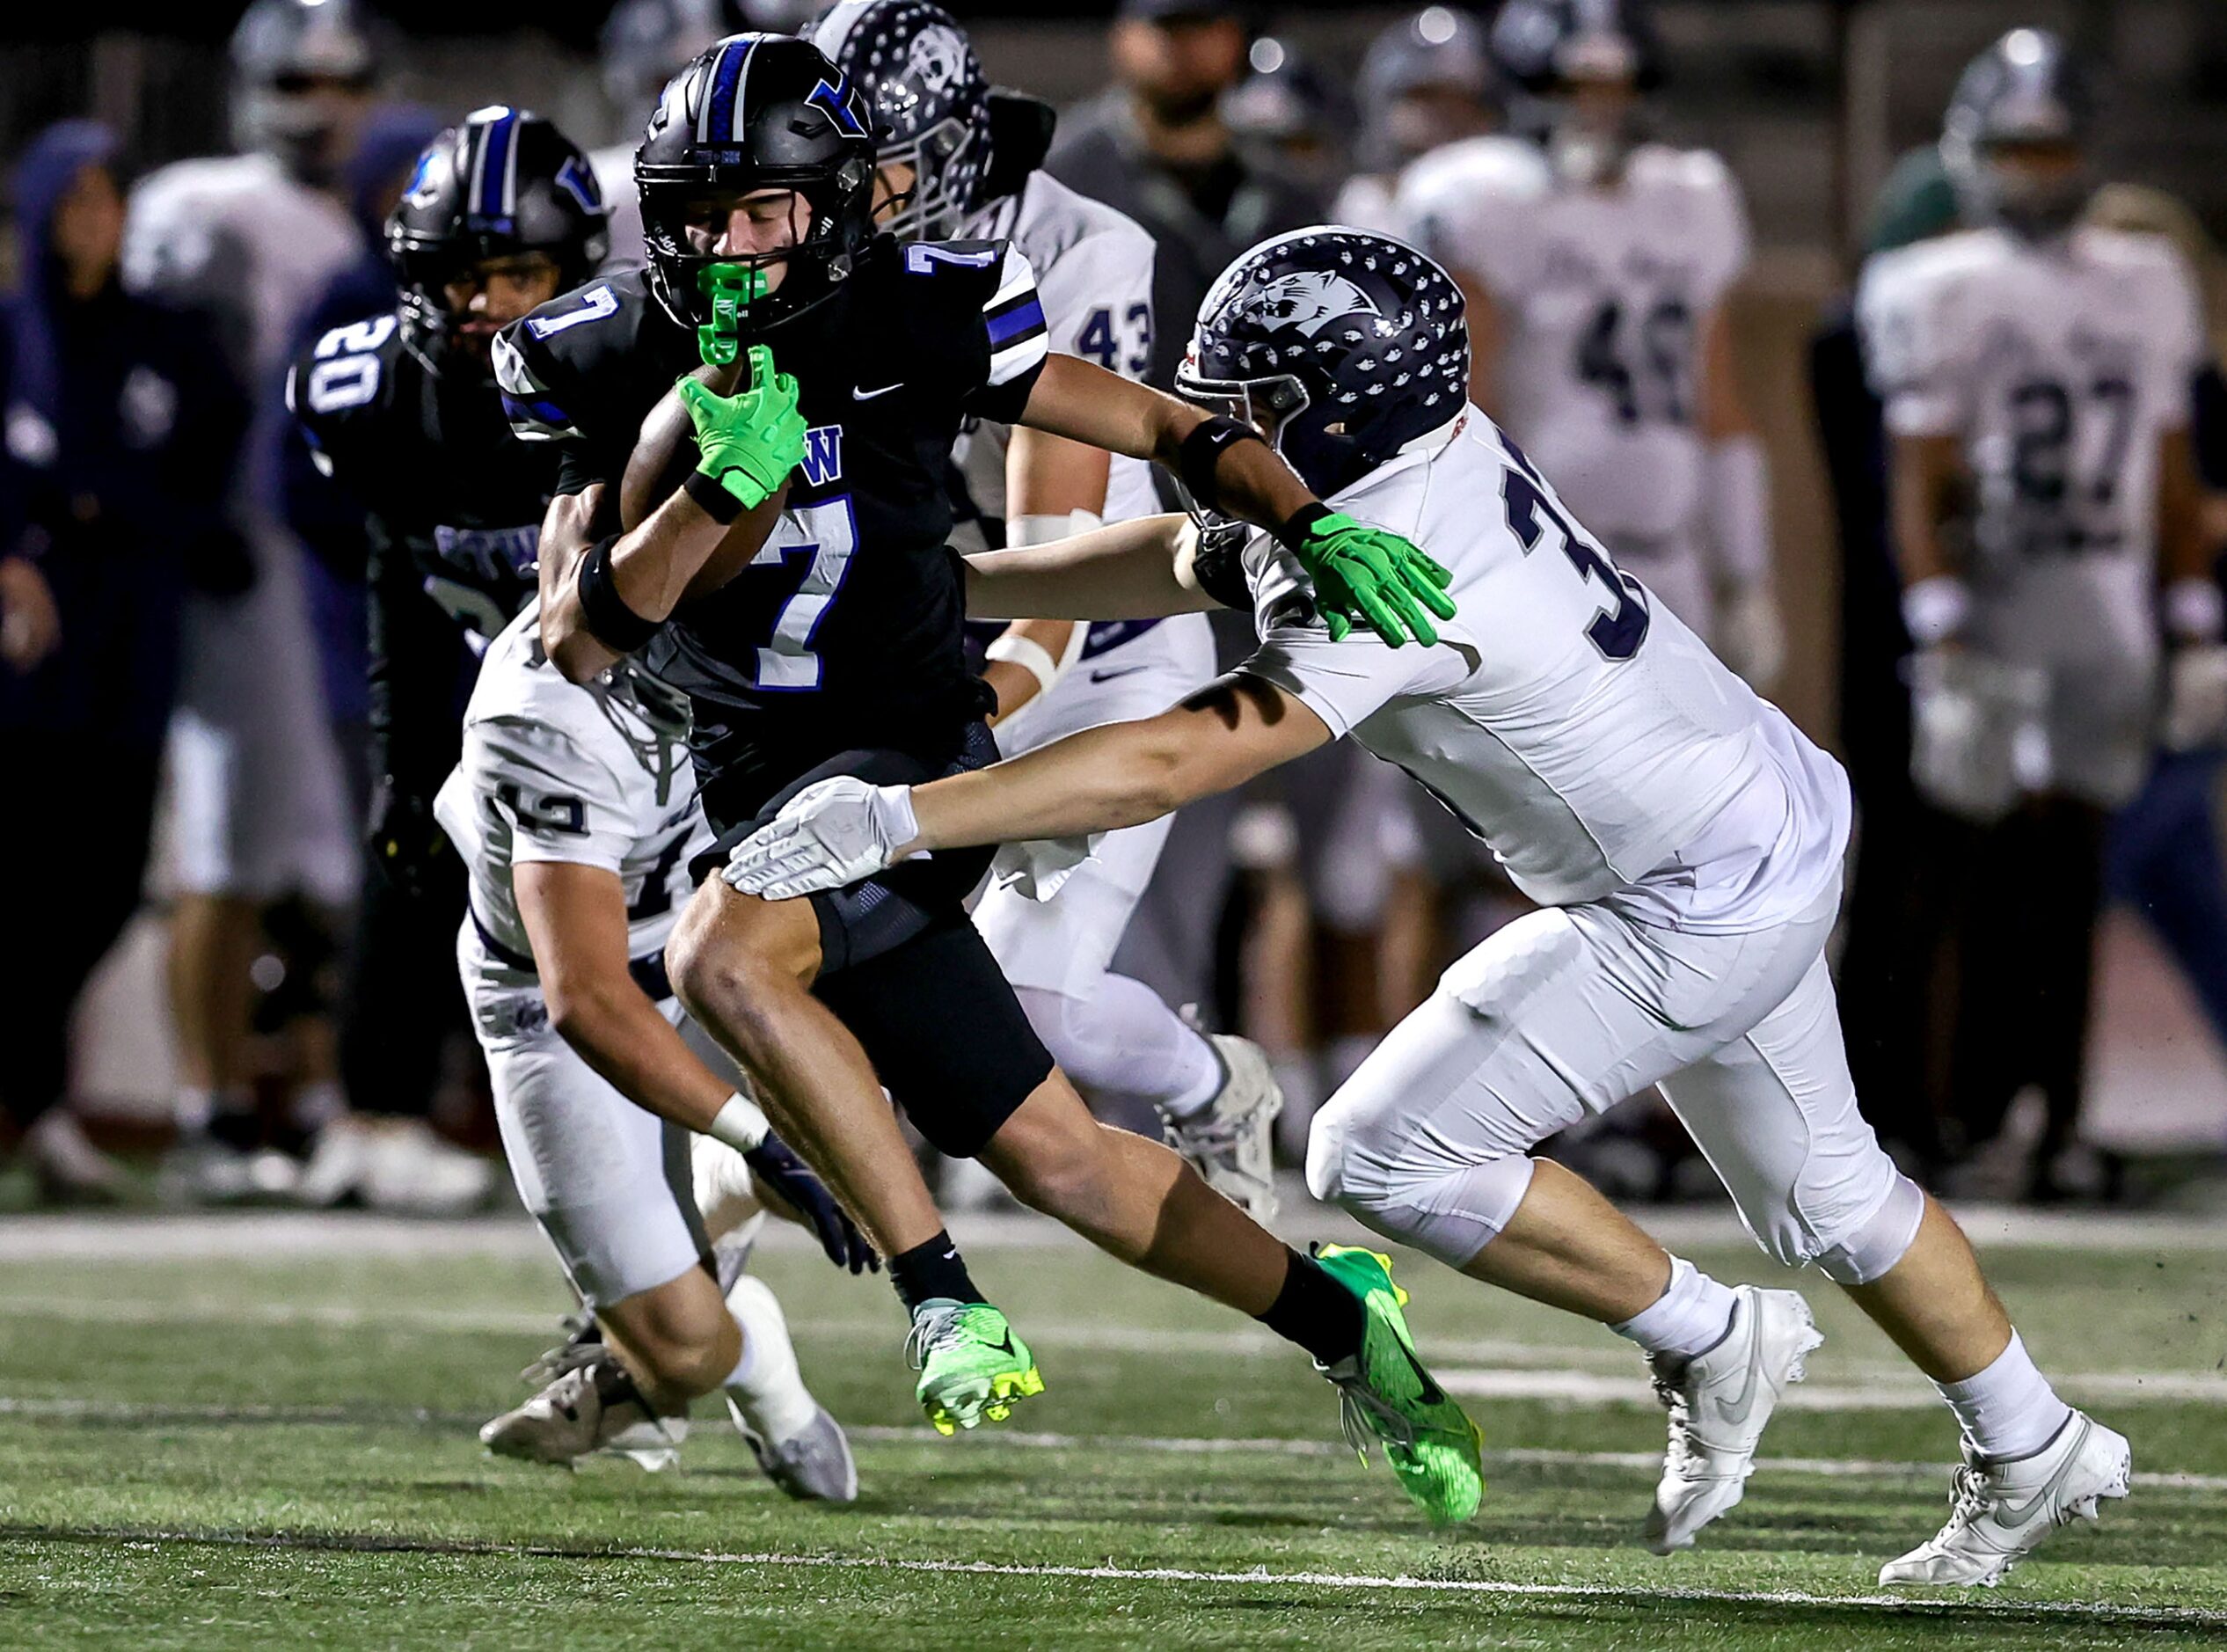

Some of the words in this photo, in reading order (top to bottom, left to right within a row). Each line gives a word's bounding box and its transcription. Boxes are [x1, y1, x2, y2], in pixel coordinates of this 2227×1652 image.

[903, 242, 997, 274] 7
[525, 284, 619, 341] 7
[1074, 302, 1152, 374] 43
[308, 314, 398, 414] 20
[800, 424, 844, 487] W
[748, 491, 859, 691] 7
